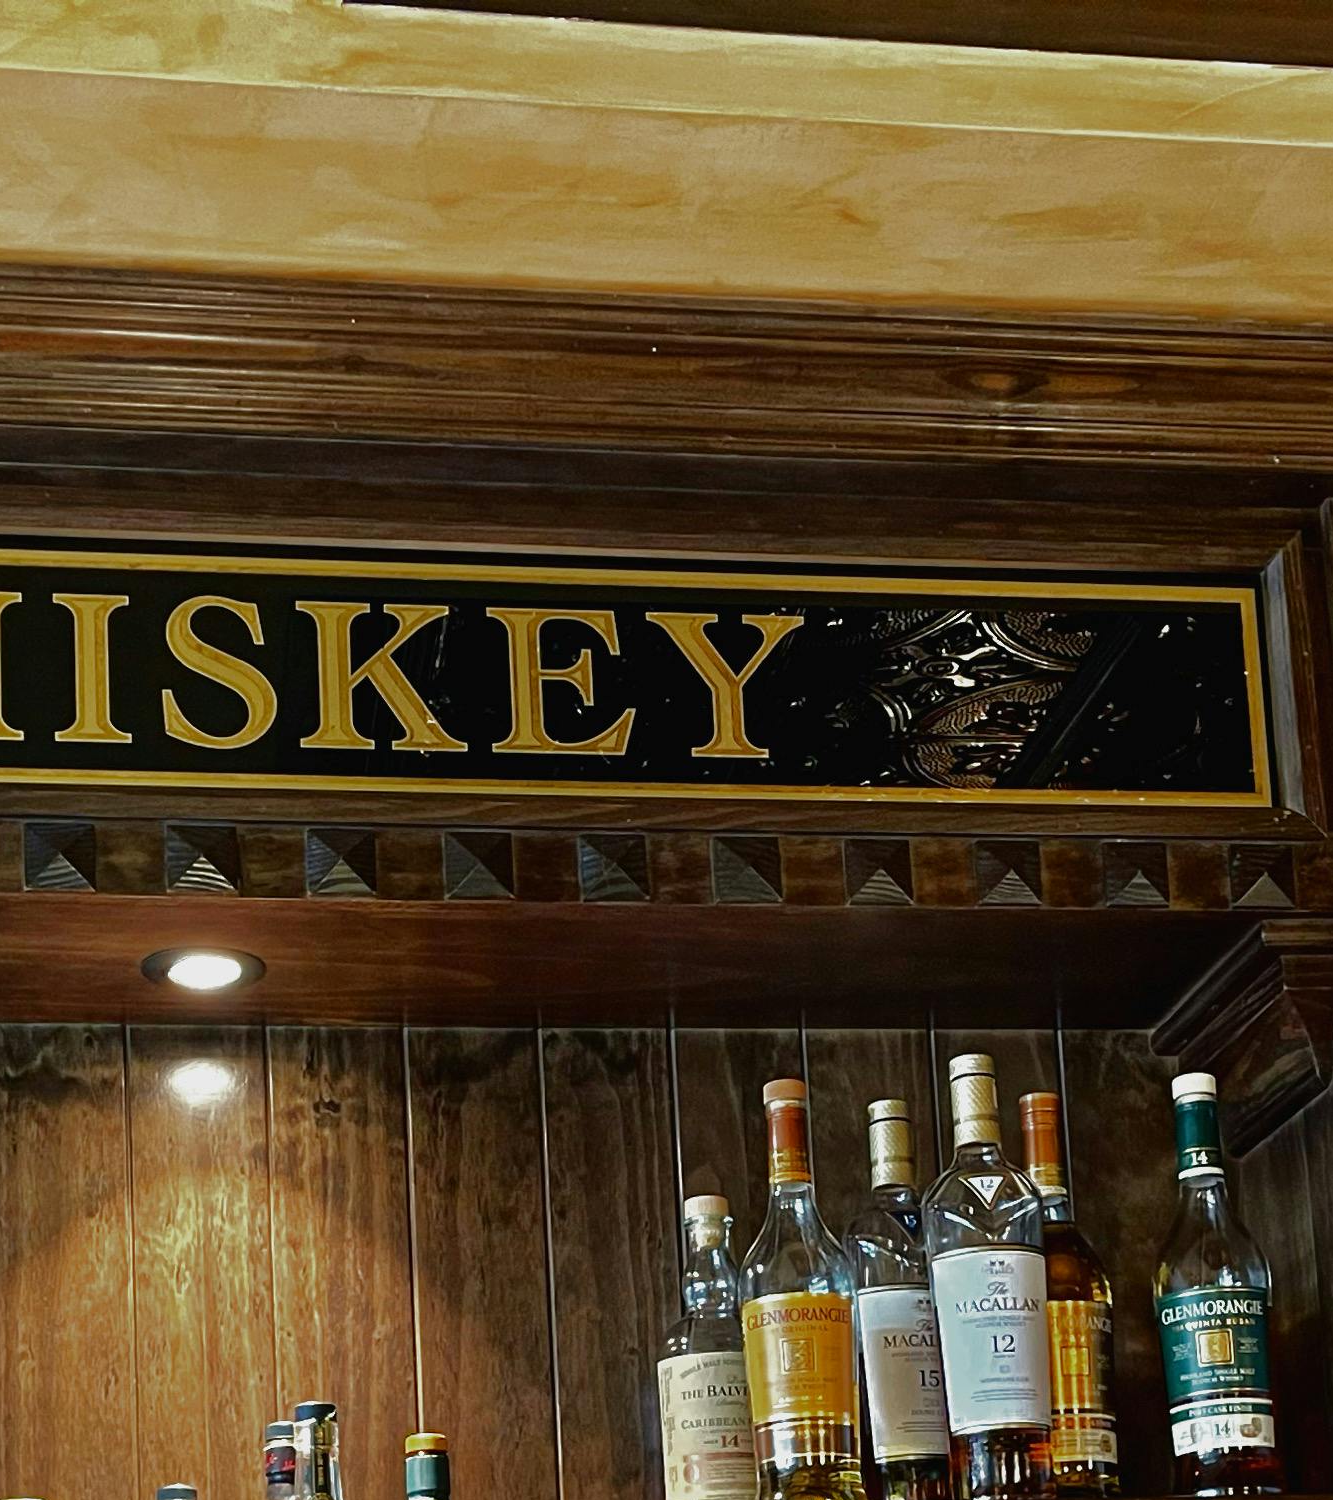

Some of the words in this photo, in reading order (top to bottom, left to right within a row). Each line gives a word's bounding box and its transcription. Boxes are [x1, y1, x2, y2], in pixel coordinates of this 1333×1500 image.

[1190, 1151, 1208, 1166] 14
[979, 1177, 995, 1190] 12
[987, 1281, 1008, 1296] The
[956, 1299, 1040, 1313] MACALLAN
[1161, 1299, 1263, 1326] GLENMORANGIE
[747, 1308, 849, 1331] GLENMORANGIE
[883, 1334, 938, 1349] MACAL
[991, 1335, 1016, 1353] 12
[919, 1370, 939, 1387] 15
[682, 1391, 704, 1400] THE
[707, 1386, 748, 1397] BALV
[681, 1416, 745, 1429] CARIBBEAN
[1214, 1423, 1230, 1435] 14
[721, 1435, 739, 1447] 14
